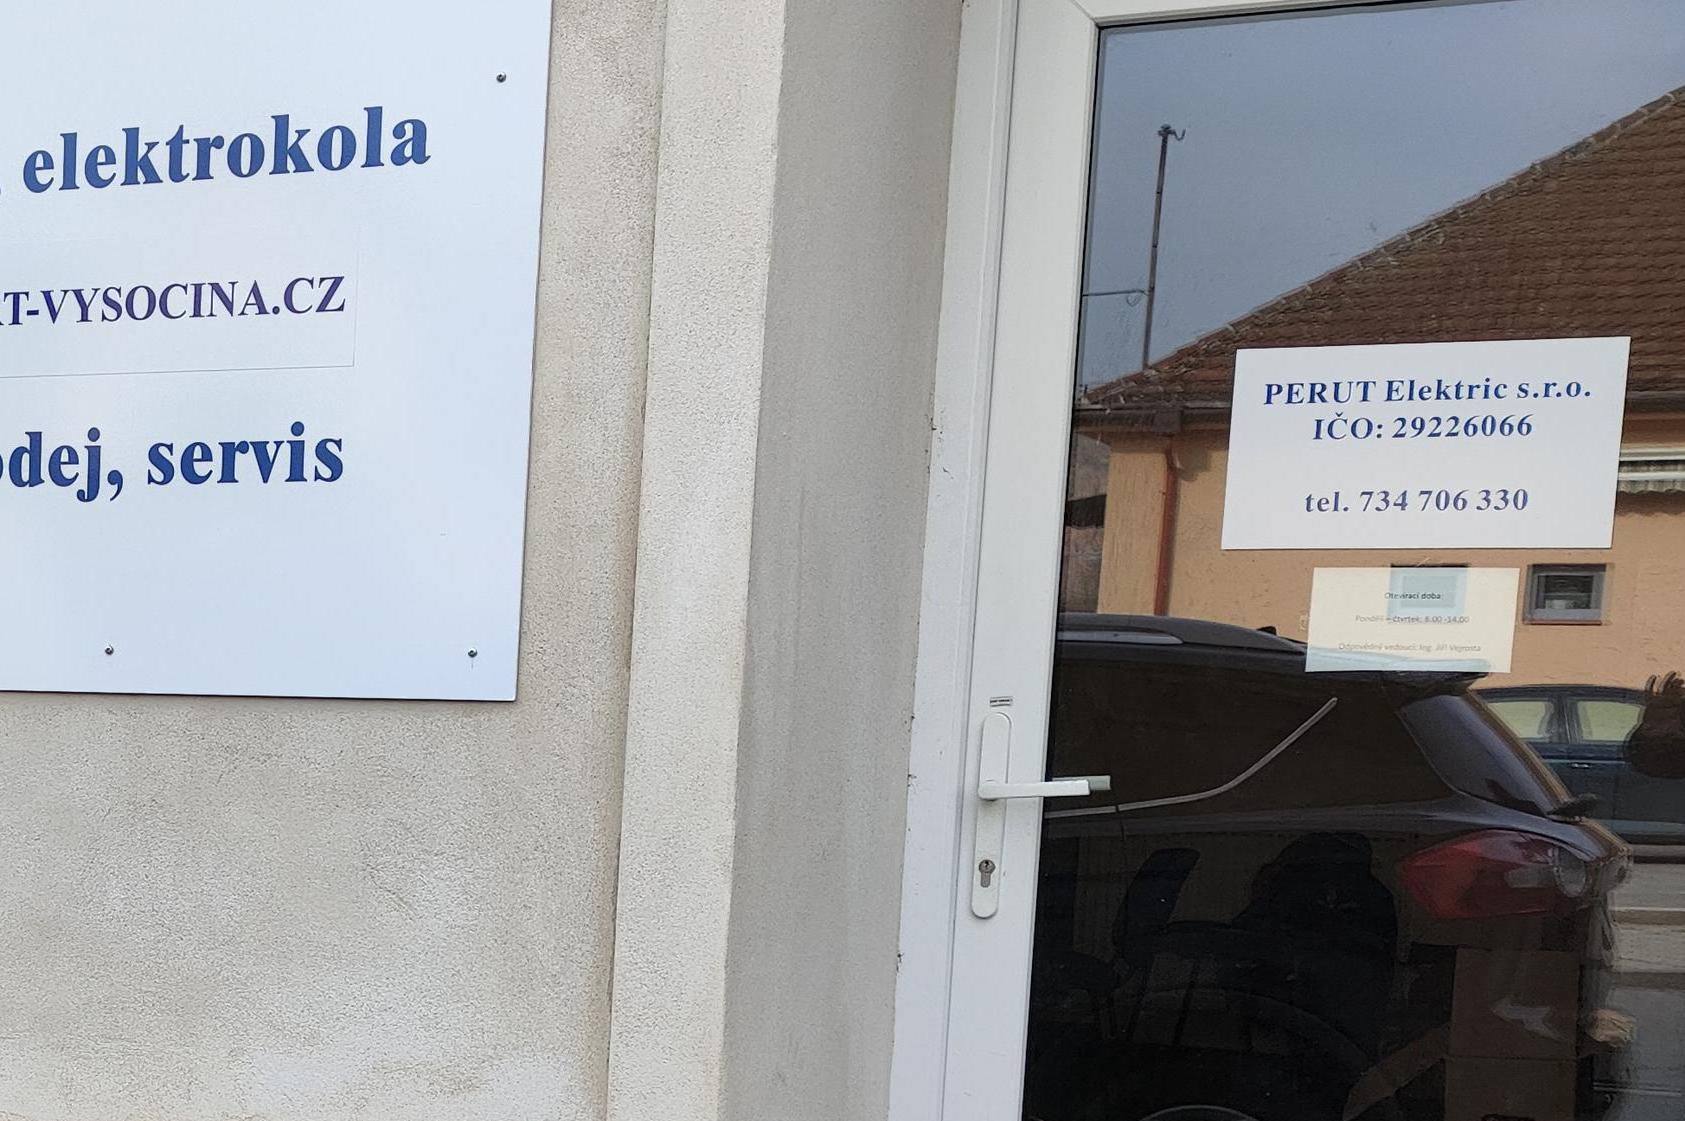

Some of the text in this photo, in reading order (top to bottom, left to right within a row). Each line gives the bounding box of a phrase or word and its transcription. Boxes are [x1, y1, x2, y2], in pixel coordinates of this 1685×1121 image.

[22, 105, 432, 195] elektrokola
[1264, 377, 1592, 405] PERUT Elektric s.r.o.
[1312, 411, 1535, 441] IČO: 29226066
[146, 420, 344, 485] servis
[1304, 488, 1530, 513] tel. 734 706 330
